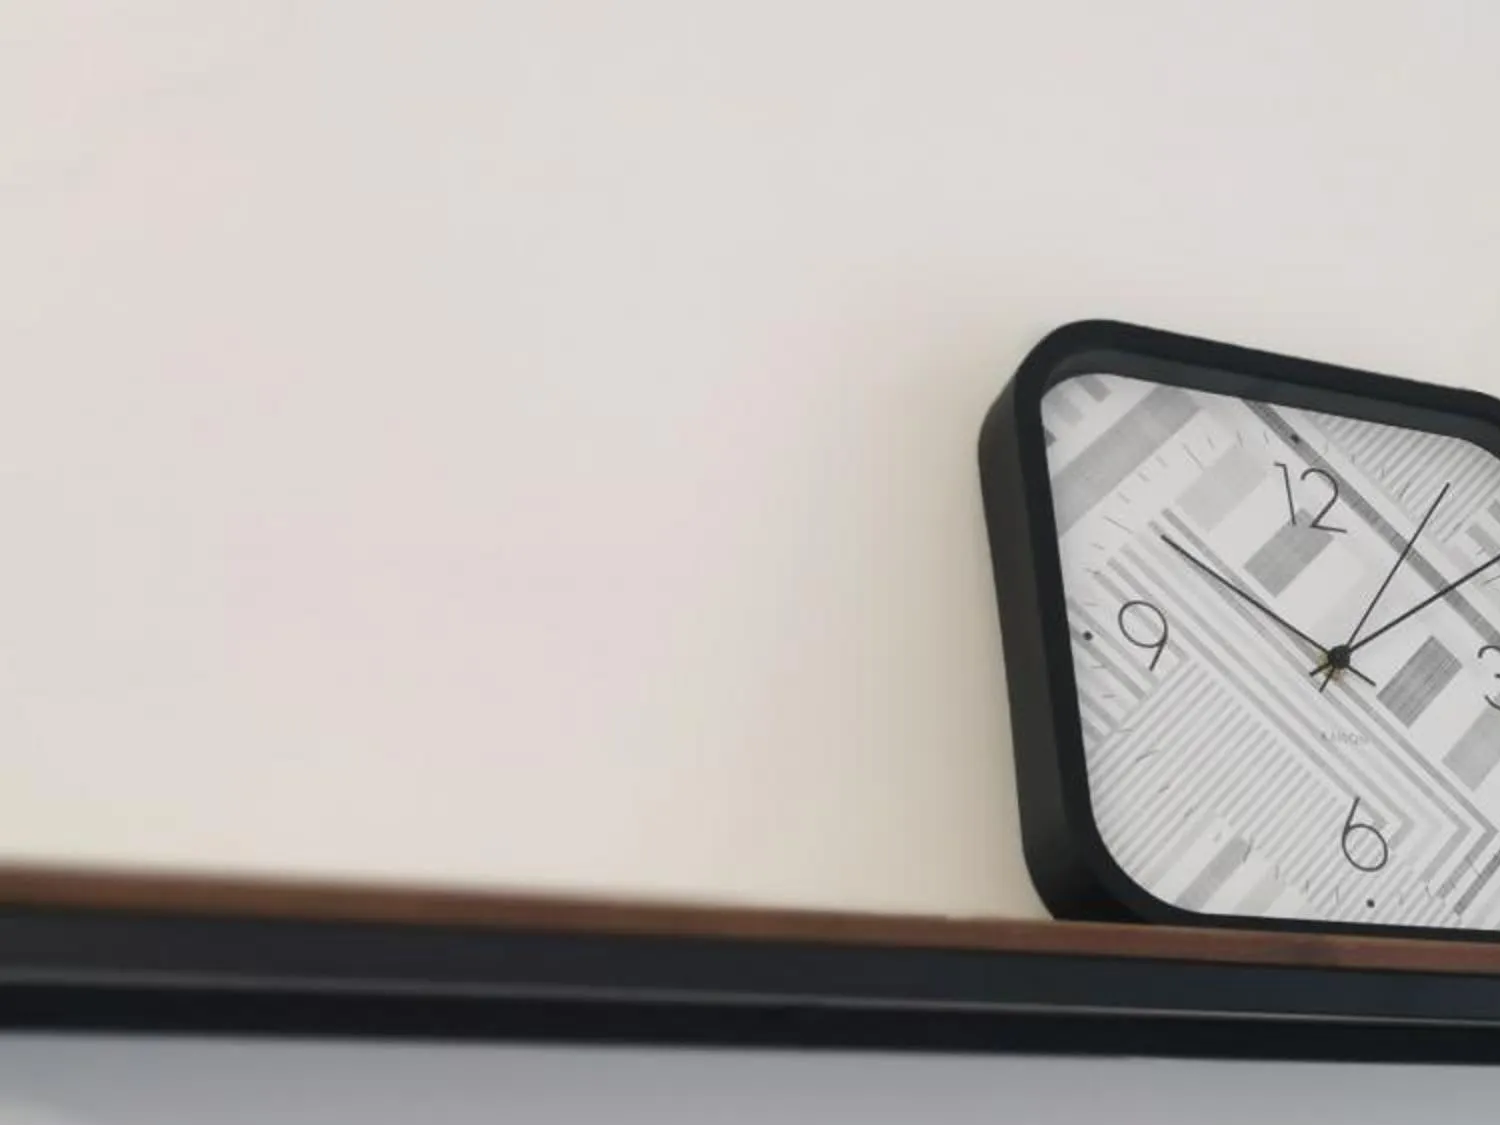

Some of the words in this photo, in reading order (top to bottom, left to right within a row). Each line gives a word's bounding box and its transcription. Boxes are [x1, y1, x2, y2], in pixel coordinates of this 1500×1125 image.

[1274, 462, 1348, 534] 12
[1117, 601, 1168, 671] 9
[1341, 796, 1388, 872] 6
